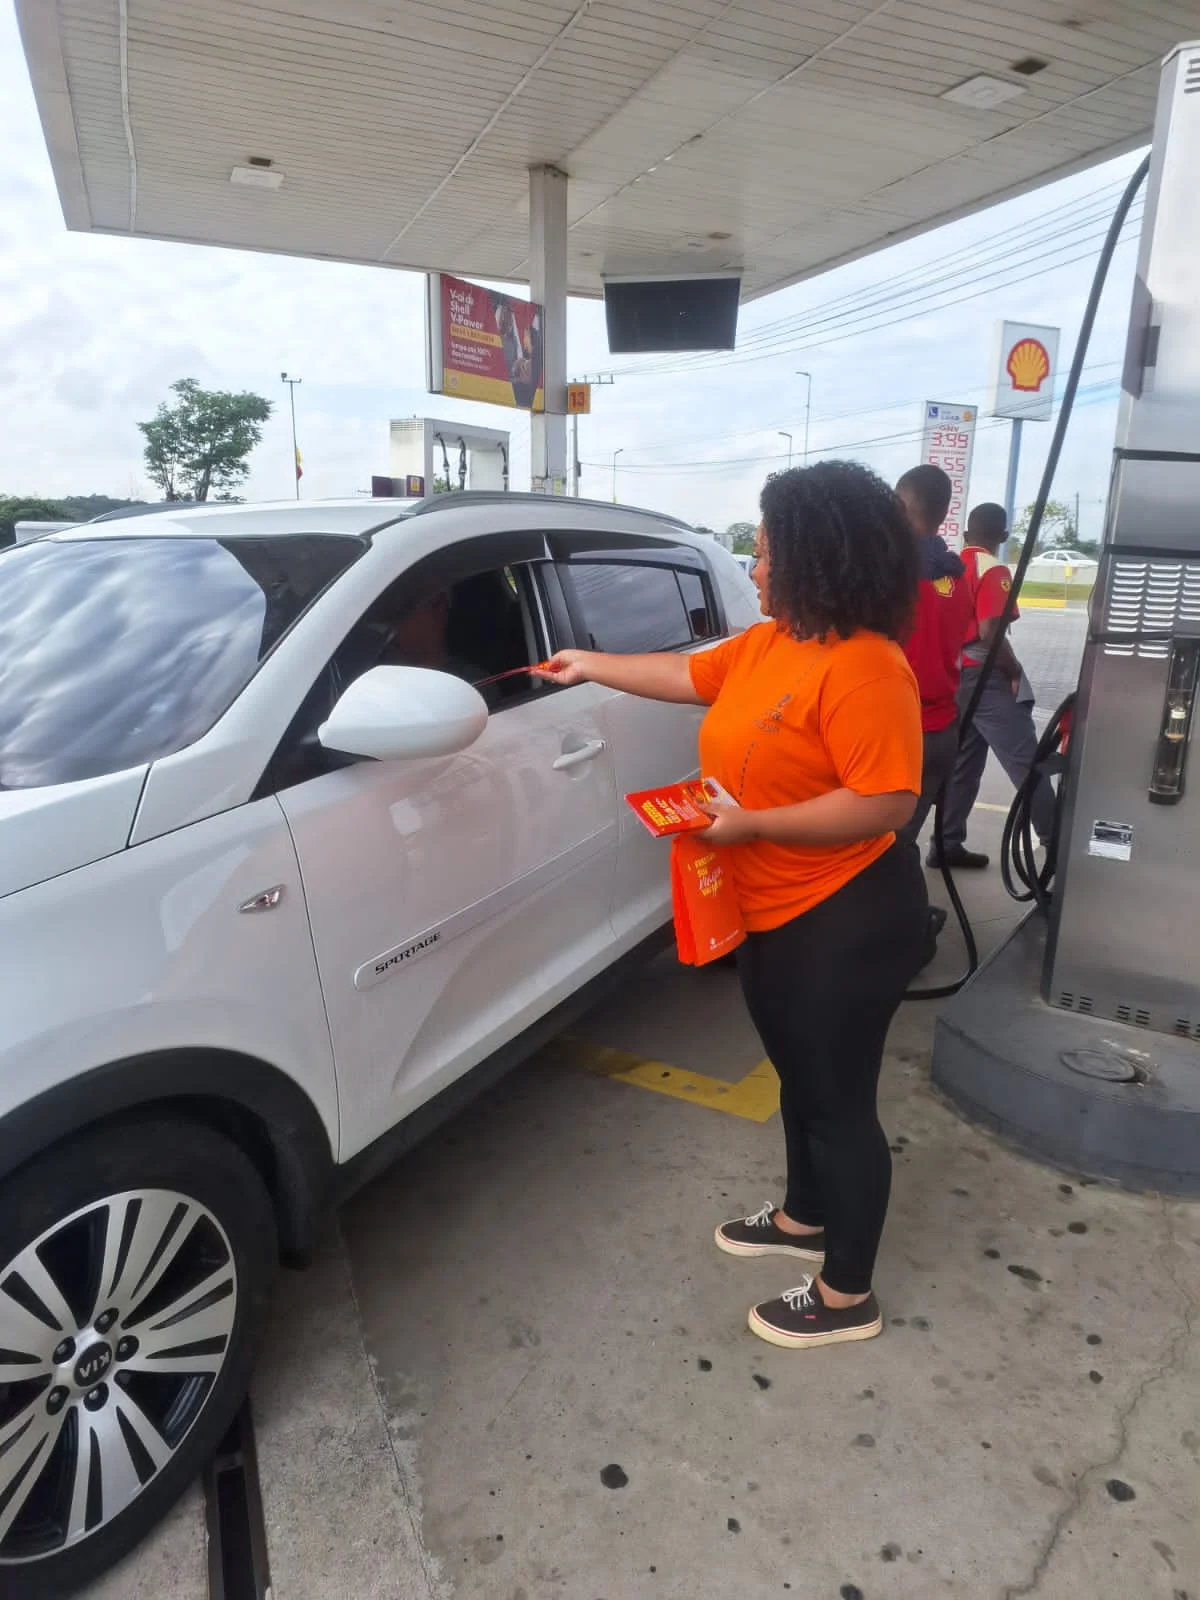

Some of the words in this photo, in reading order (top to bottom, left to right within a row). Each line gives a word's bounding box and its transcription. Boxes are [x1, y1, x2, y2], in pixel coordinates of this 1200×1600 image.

[450, 300, 471, 315] Shell
[450, 312, 484, 330] V-Power
[570, 391, 585, 409] 13
[930, 432, 969, 449] 3.99
[375, 931, 441, 976] SPORTAGE
[79, 1351, 110, 1378] KIA
